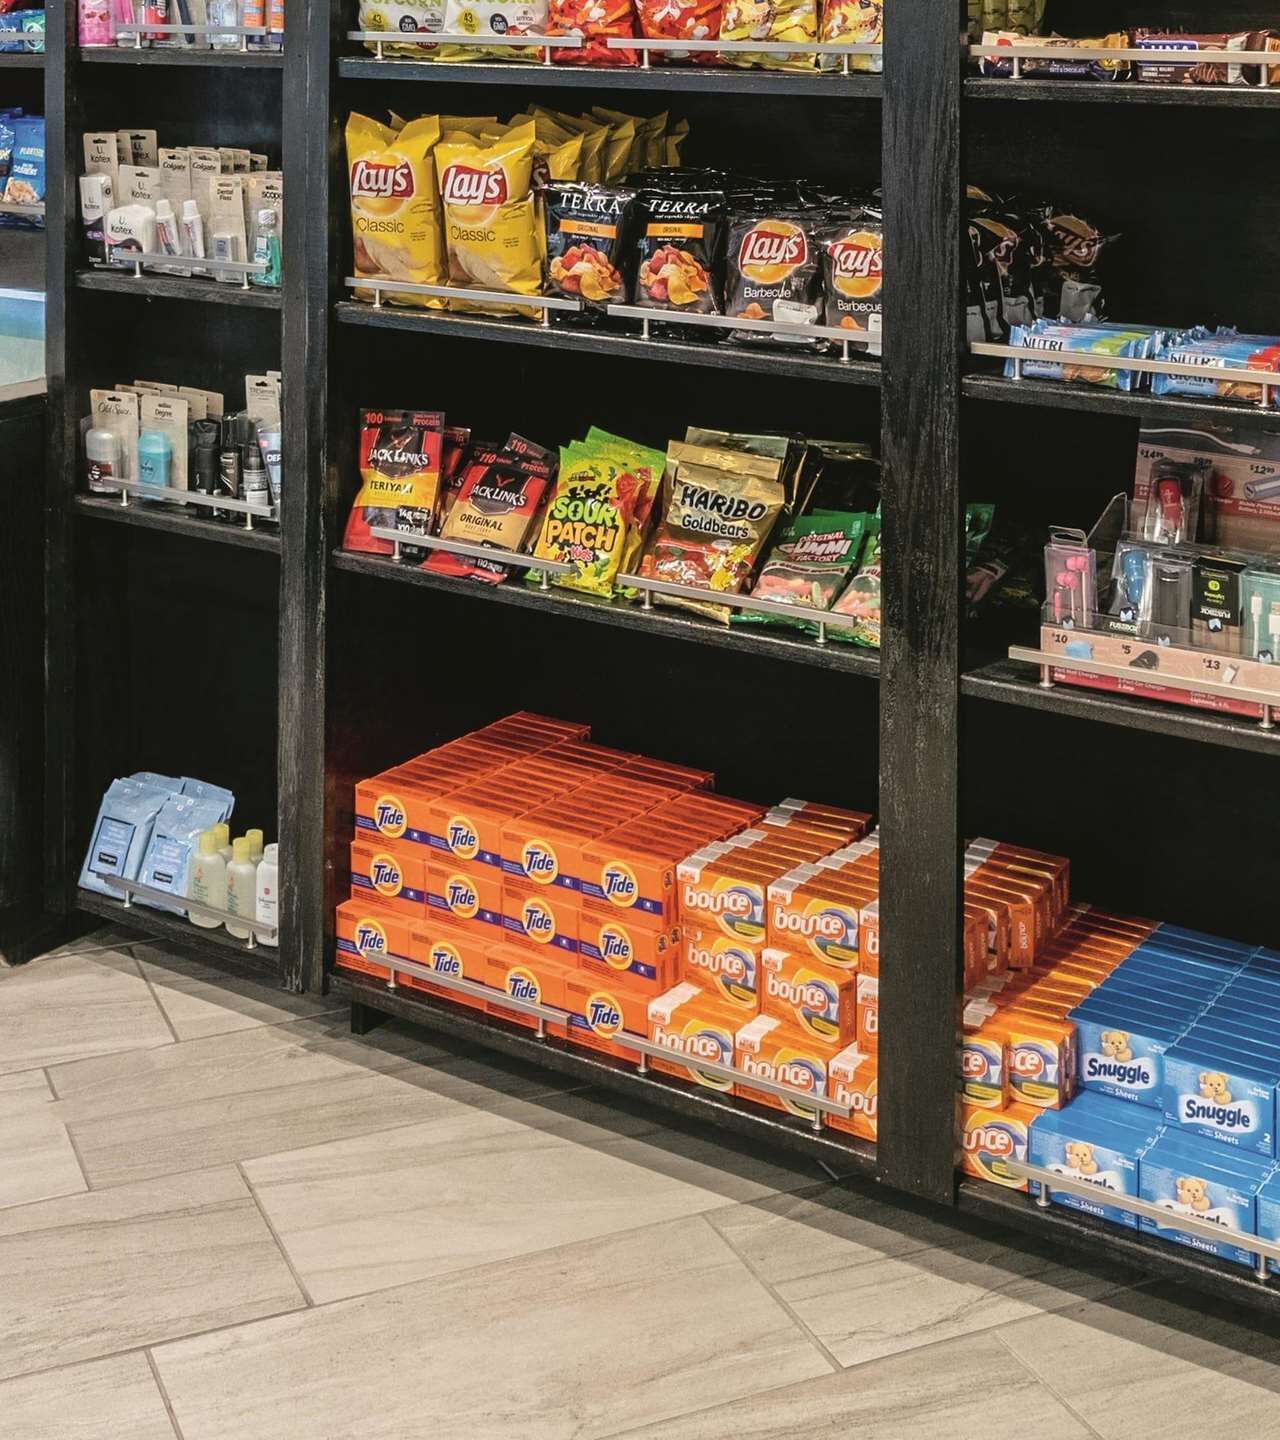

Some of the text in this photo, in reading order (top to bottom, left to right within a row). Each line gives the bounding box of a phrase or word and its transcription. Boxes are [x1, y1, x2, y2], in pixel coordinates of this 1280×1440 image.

[463, 12, 473, 24] 43
[163, 162, 186, 171] Colgate
[193, 162, 216, 171] Colgate
[352, 160, 408, 198] Lay's
[444, 166, 502, 206] Lay's
[560, 192, 621, 215] TERRA
[649, 199, 712, 214] TERRA
[356, 217, 405, 234] Classic
[451, 226, 496, 243] Classic
[742, 230, 802, 265] Lay's
[744, 286, 791, 298] Barbecue
[155, 409, 173, 417] Degree
[366, 413, 383, 424] 100
[370, 449, 393, 461] JACK
[472, 485, 493, 499] JACK
[552, 496, 617, 528] SOUR
[680, 485, 767, 522] HARIBO
[460, 513, 503, 531] ORIGINAL
[682, 514, 749, 539] Goldbears
[547, 523, 616, 553] PATCH
[1051, 632, 1068, 644] $10
[1121, 644, 1131, 655] $5
[1202, 658, 1220, 670] $13
[378, 806, 403, 827] Tide
[450, 826, 475, 847] Tide
[525, 849, 554, 871] Tide
[374, 864, 399, 884] Tide
[604, 872, 634, 894] Tide
[448, 885, 475, 905] Tide
[684, 886, 749, 912] bounce
[524, 908, 552, 930] Tide
[774, 907, 843, 936] bounce
[358, 929, 384, 950] Tide
[603, 934, 632, 956] Tide
[433, 952, 459, 973] Tide
[688, 942, 744, 974] bounce
[509, 978, 537, 999] Tide
[767, 974, 826, 1008] bounce
[590, 1003, 619, 1025] Tide
[1087, 1058, 1150, 1085] Snuggle
[1115, 1088, 1139, 1101] Sheets
[1185, 1100, 1250, 1128] Snuggle
[1214, 1131, 1239, 1145] Sheets
[1264, 1133, 1271, 1143] 2
[1080, 1201, 1105, 1216] Sheets
[1192, 1238, 1217, 1254] Sheets
